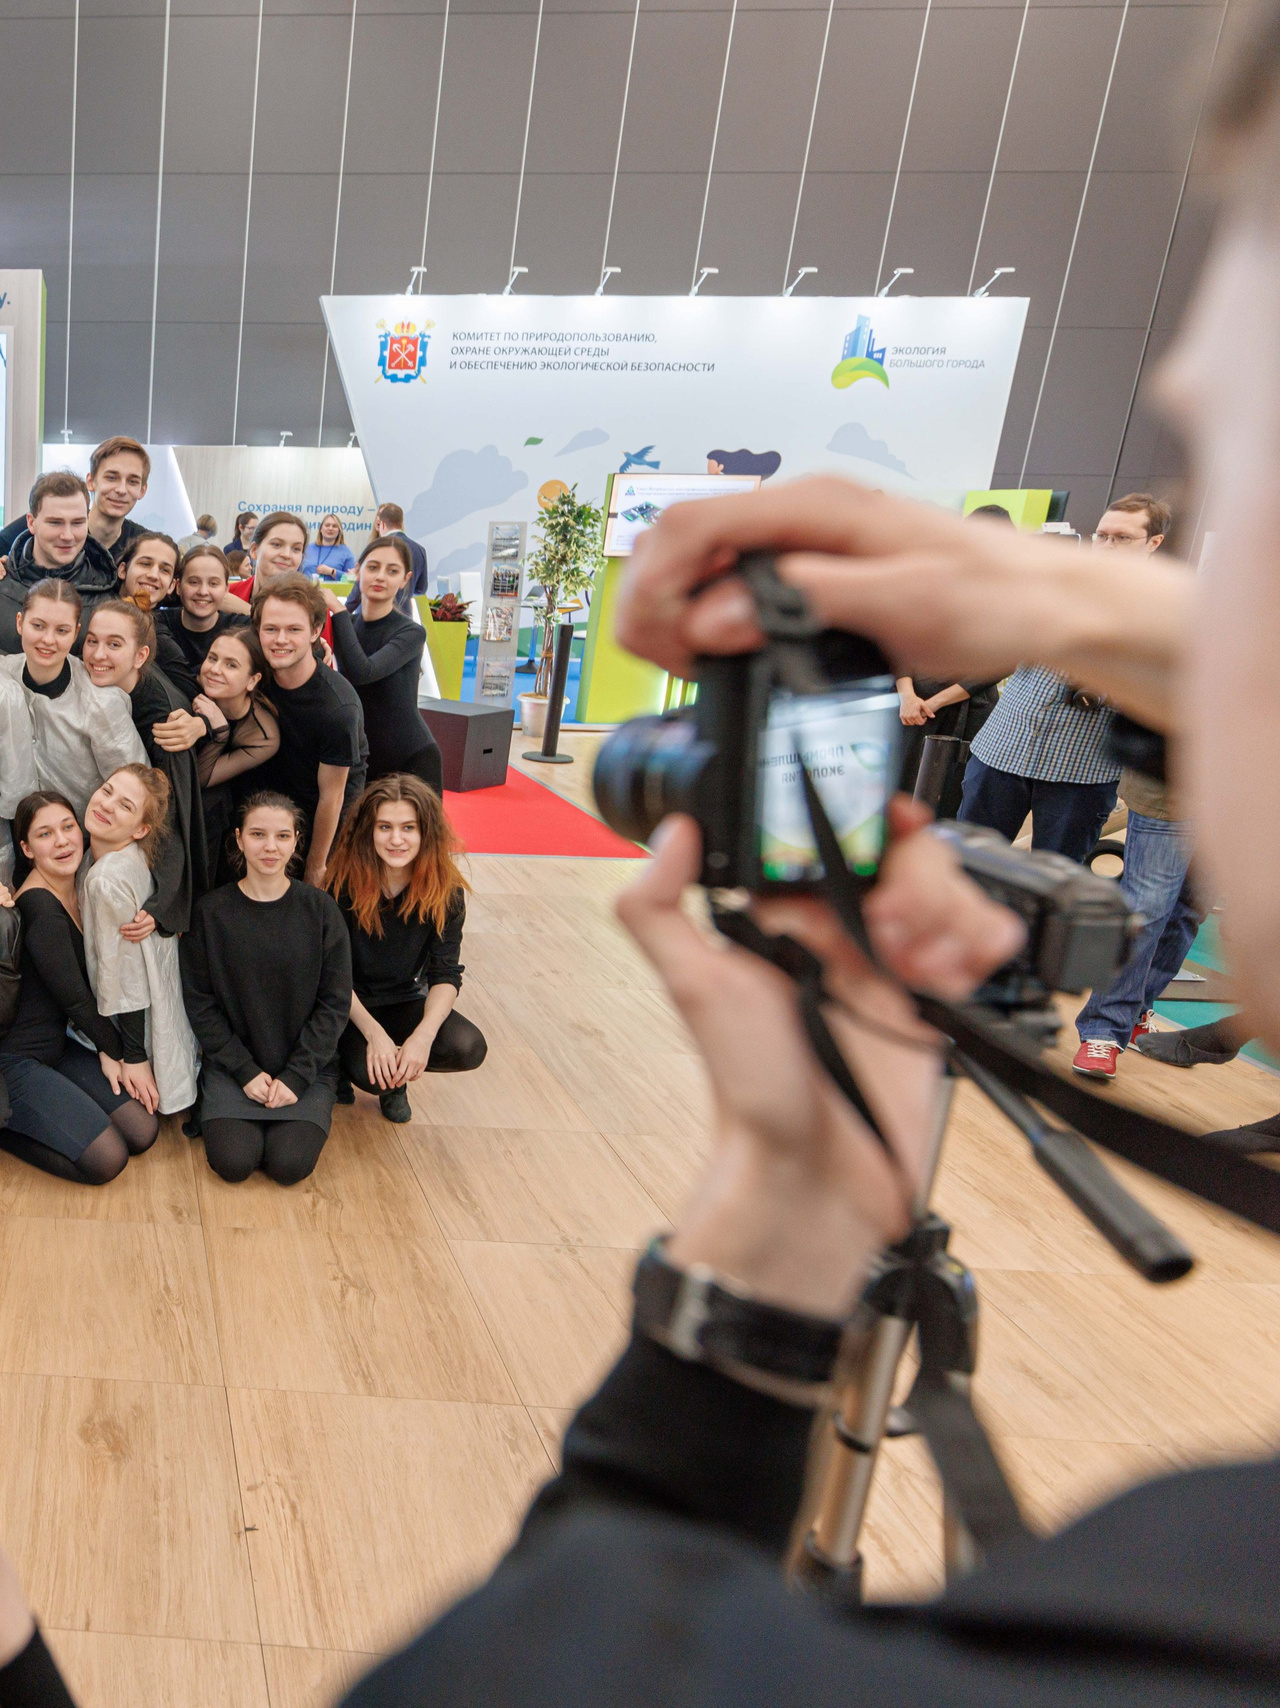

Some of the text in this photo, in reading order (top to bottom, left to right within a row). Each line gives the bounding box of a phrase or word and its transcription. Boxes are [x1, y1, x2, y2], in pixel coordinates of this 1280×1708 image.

[452, 331, 658, 344] КОМИТЕТ ПО ПРИРОДОПОЛЬЗОВАНИЮ,
[450, 345, 610, 358] ОХРАНЕ ОКРУЖАЮЩЕЙ СРЕДЫ
[891, 346, 947, 356] ЭКОЛОГИЯ
[449, 360, 716, 373] И ОБЕСПЕЧЕНИЮ ЭКОЛОГИЧЕСКОЙ БЕЗОПАСНОСТИ
[888, 358, 986, 370] БОЛЬШОГО ГОРОДА
[237, 500, 303, 515] Сохраняя
[306, 504, 365, 516] природу
